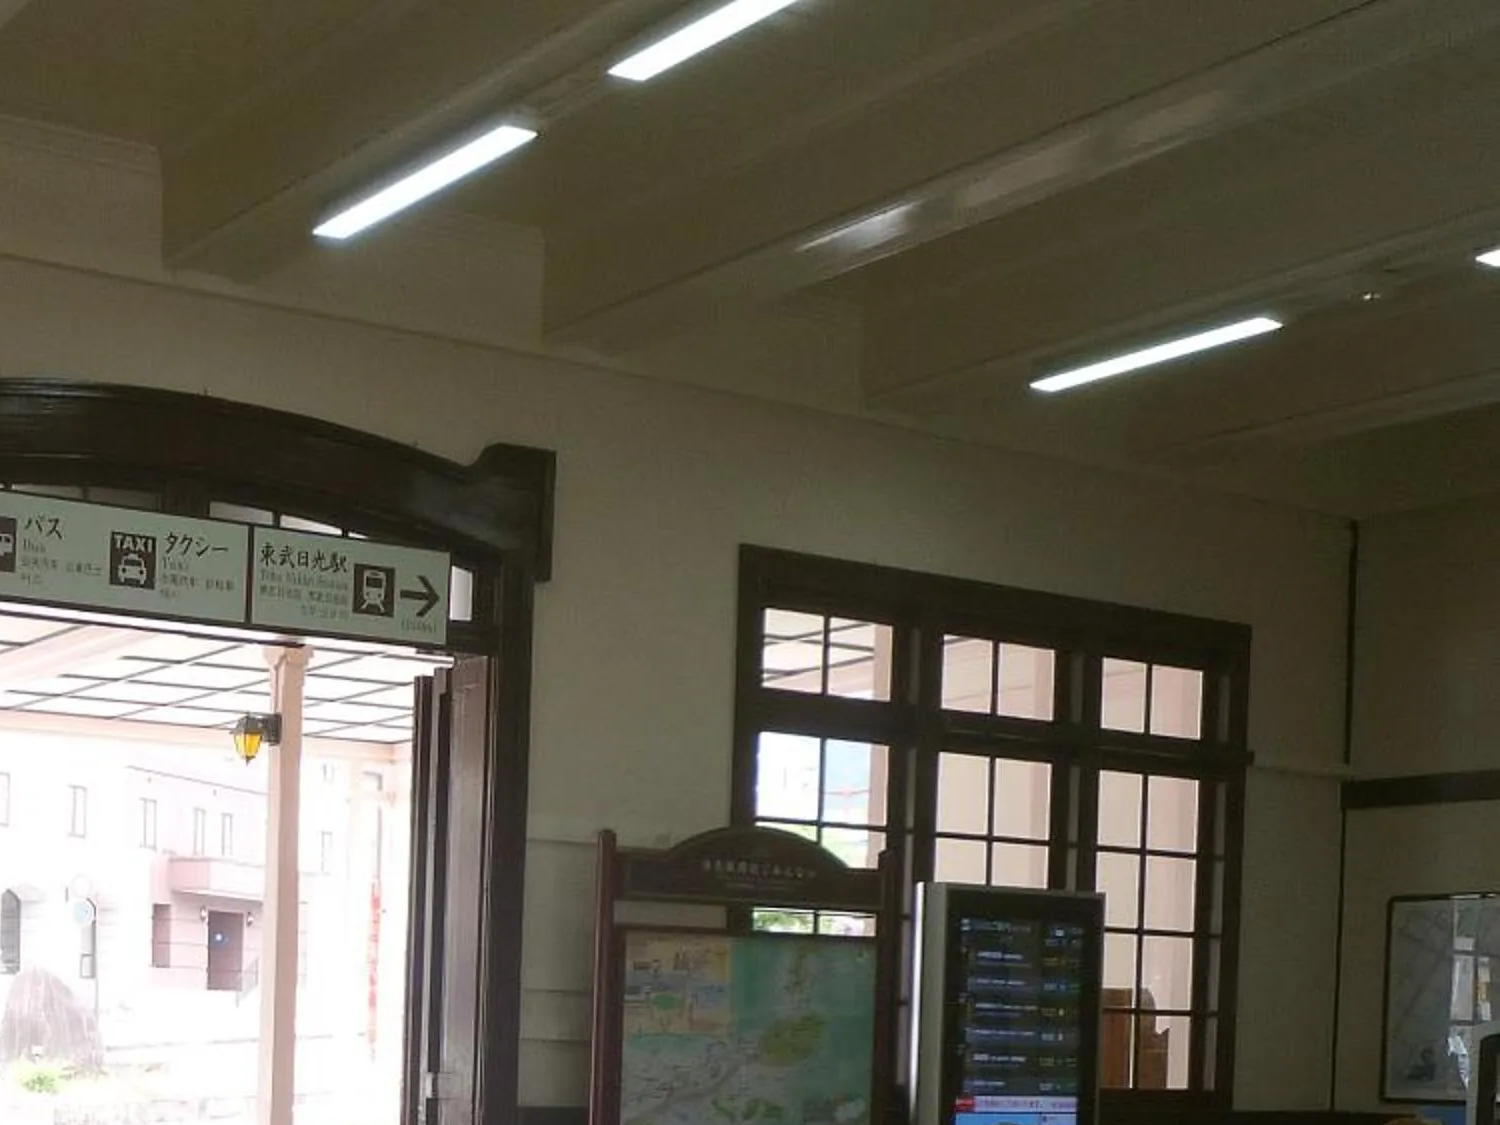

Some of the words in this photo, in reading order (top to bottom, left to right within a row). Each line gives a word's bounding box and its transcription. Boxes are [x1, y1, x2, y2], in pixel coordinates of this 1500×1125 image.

[24, 516, 64, 541] バス
[113, 534, 155, 554] TAXI
[163, 531, 230, 557] タクシー
[260, 541, 349, 574] 東武日光駅
